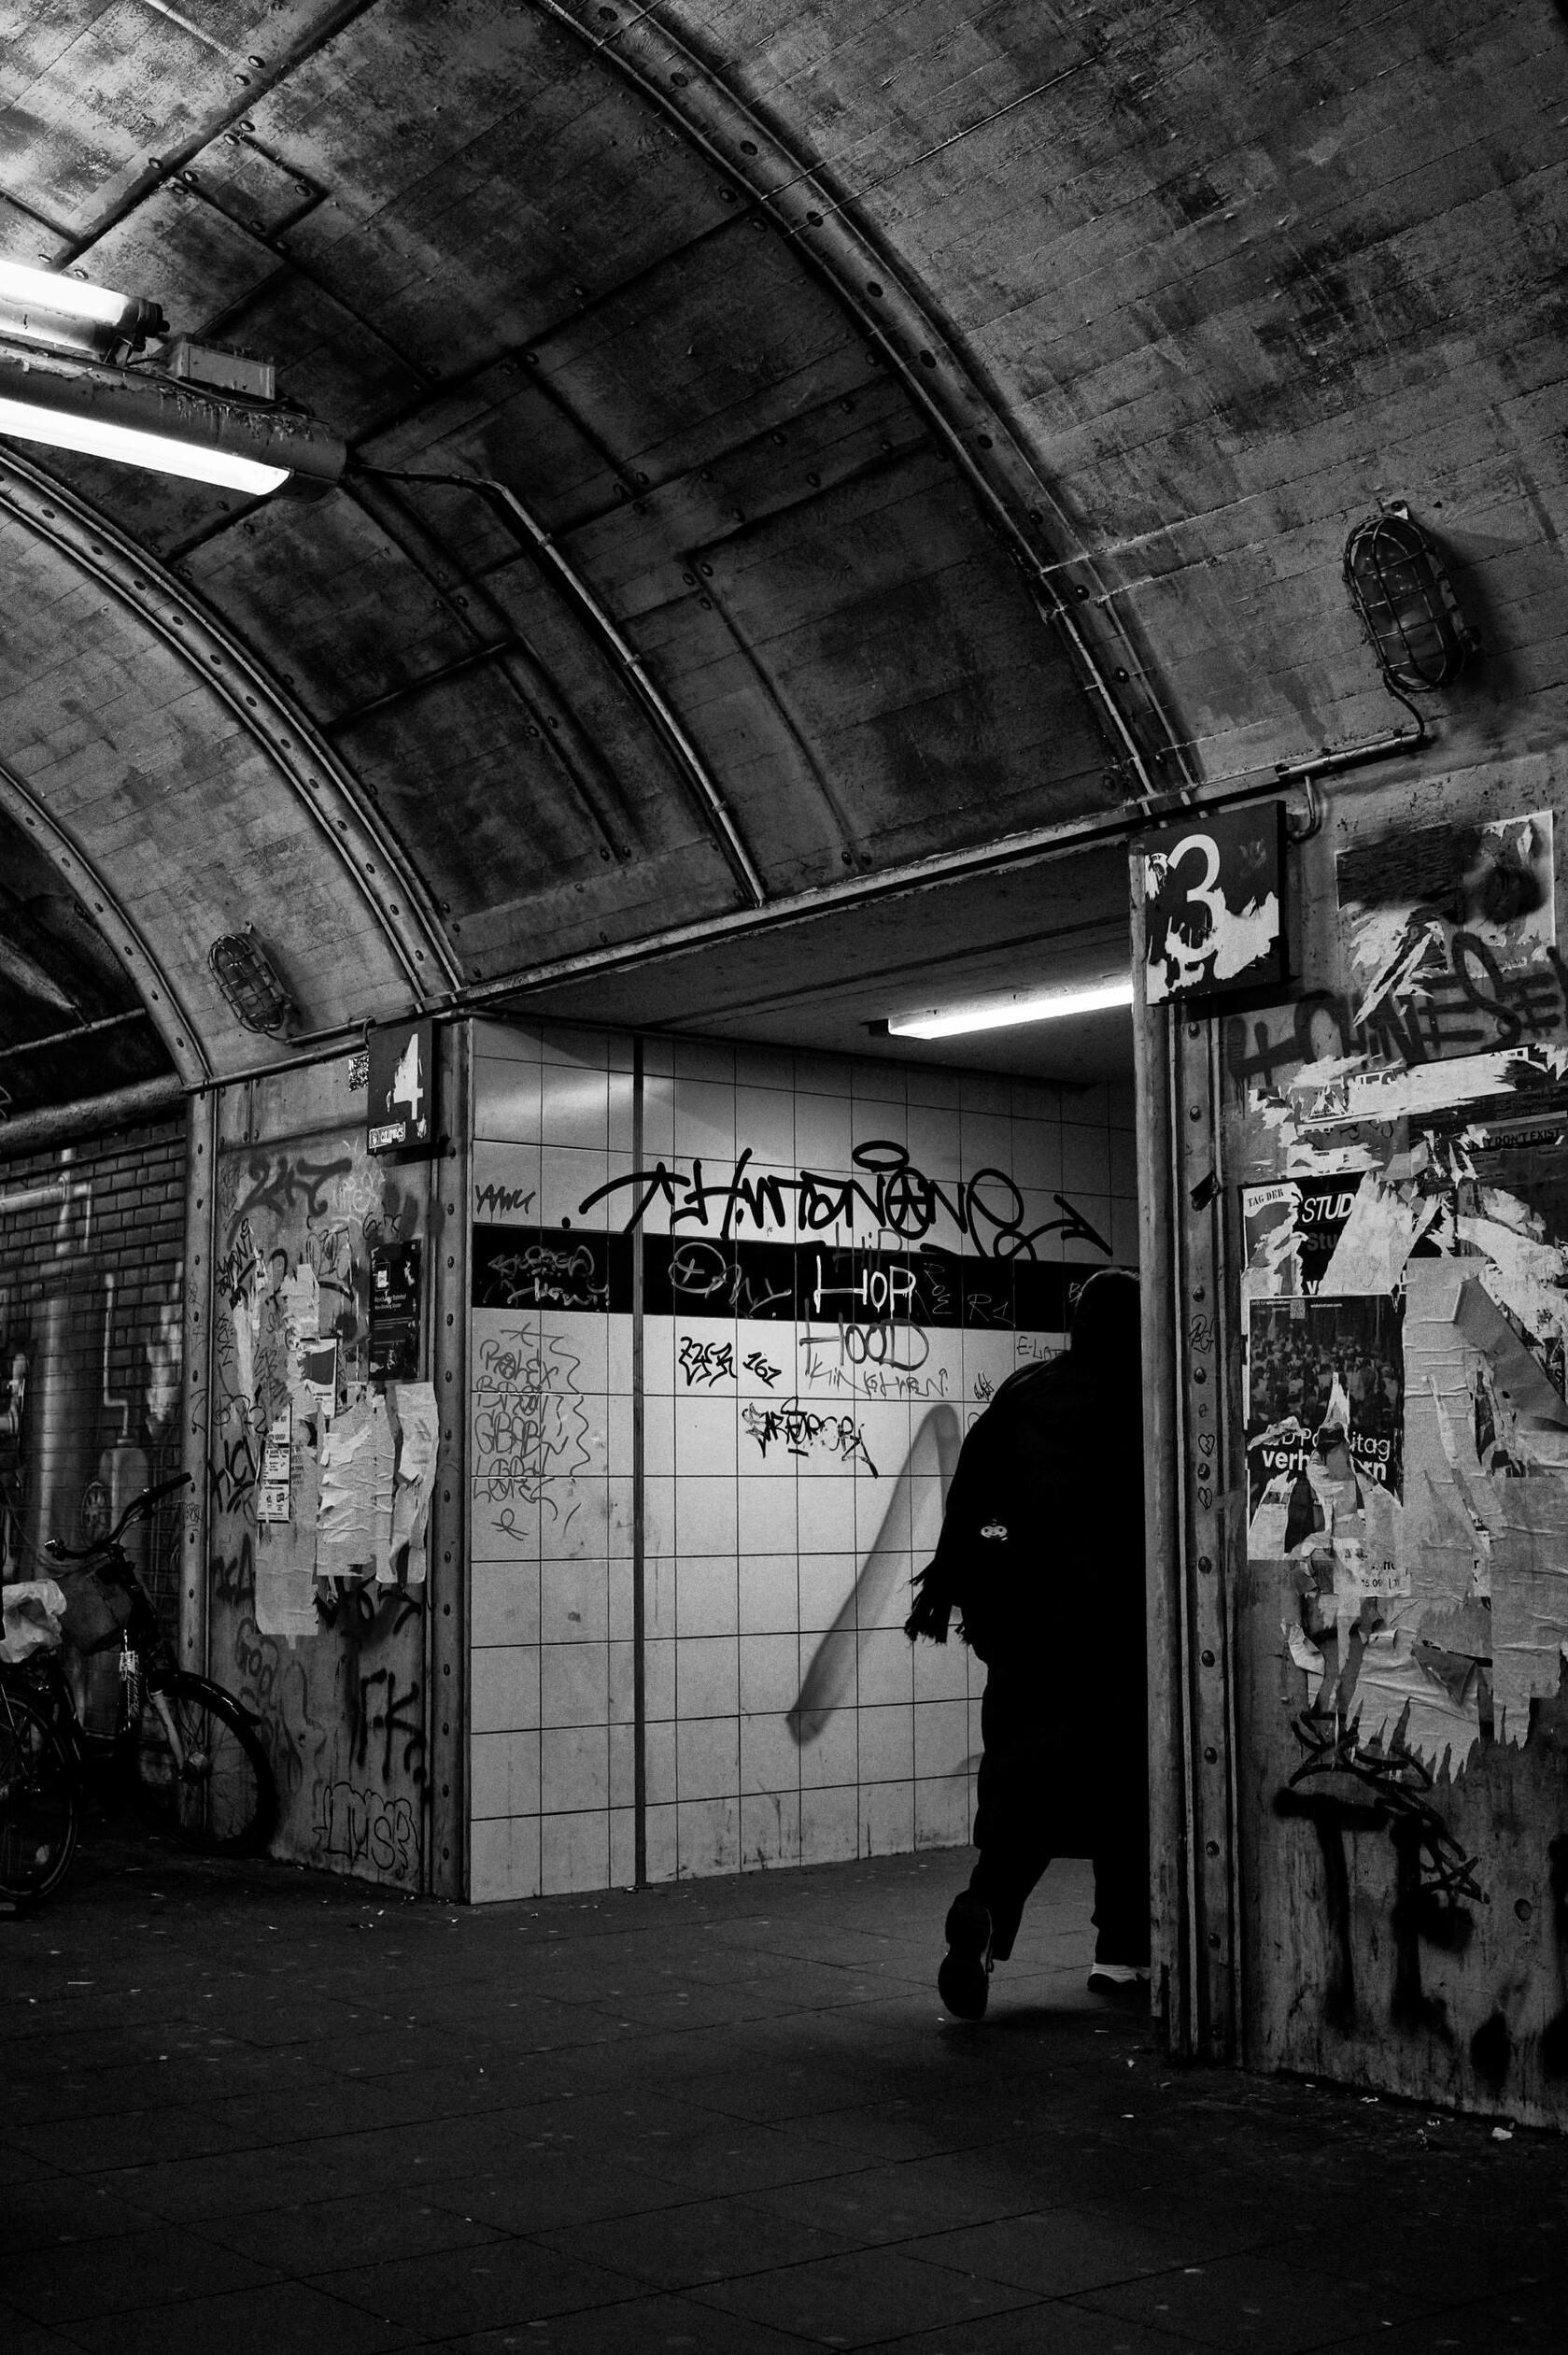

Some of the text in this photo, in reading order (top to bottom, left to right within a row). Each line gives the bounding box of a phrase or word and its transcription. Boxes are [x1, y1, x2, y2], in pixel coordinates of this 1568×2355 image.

[1165, 833, 1221, 963] 3
[394, 1033, 423, 1120] 4
[1247, 1188, 1284, 1208] TAG DER
[1302, 1192, 1356, 1224] STUD
[813, 1256, 916, 1317] HOP
[799, 1298, 929, 1376] HOOD
